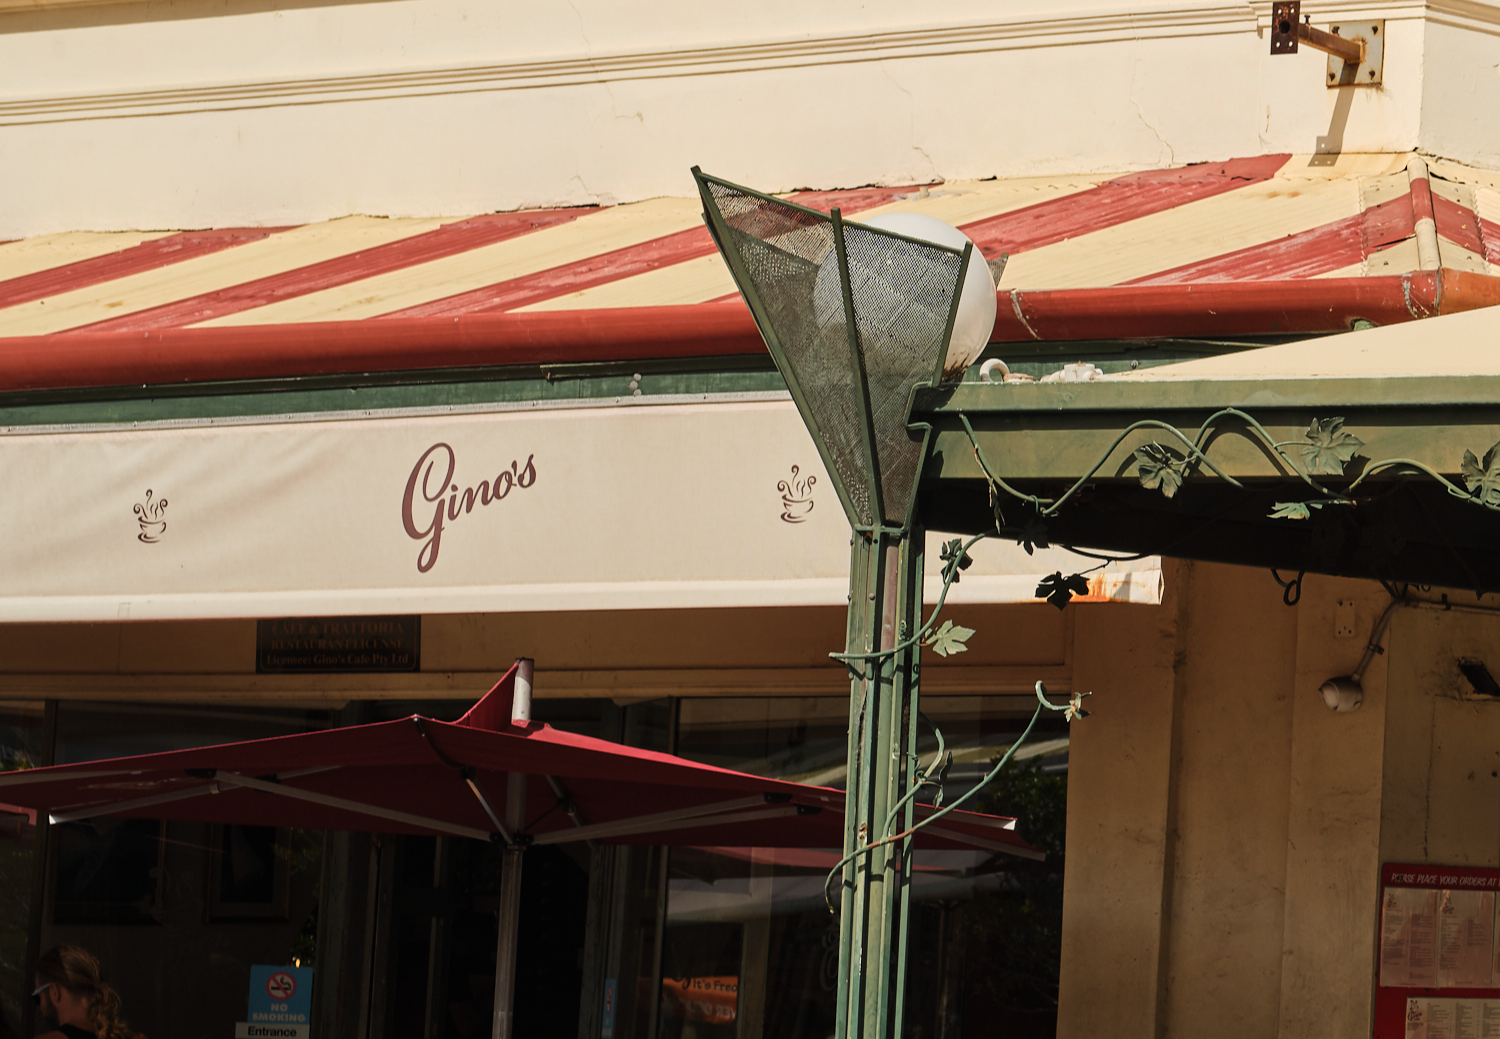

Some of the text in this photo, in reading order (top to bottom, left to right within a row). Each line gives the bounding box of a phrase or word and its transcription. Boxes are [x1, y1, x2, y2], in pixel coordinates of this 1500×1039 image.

[402, 442, 537, 573] Gino's
[272, 623, 304, 635] CAFE
[323, 621, 404, 635] TRATTORIA
[271, 639, 349, 650] RESTAURANT
[267, 653, 409, 666] Licensee: Gino's Cafe Pty Ltd
[1417, 874, 1437, 885] PLACE
[1439, 875, 1458, 886] YOUR
[1459, 876, 1487, 887] ORDERS
[1487, 878, 1497, 887] AT
[270, 1003, 288, 1012] NO
[252, 1012, 306, 1023] SMOKING
[248, 1026, 297, 1037] Entrance
